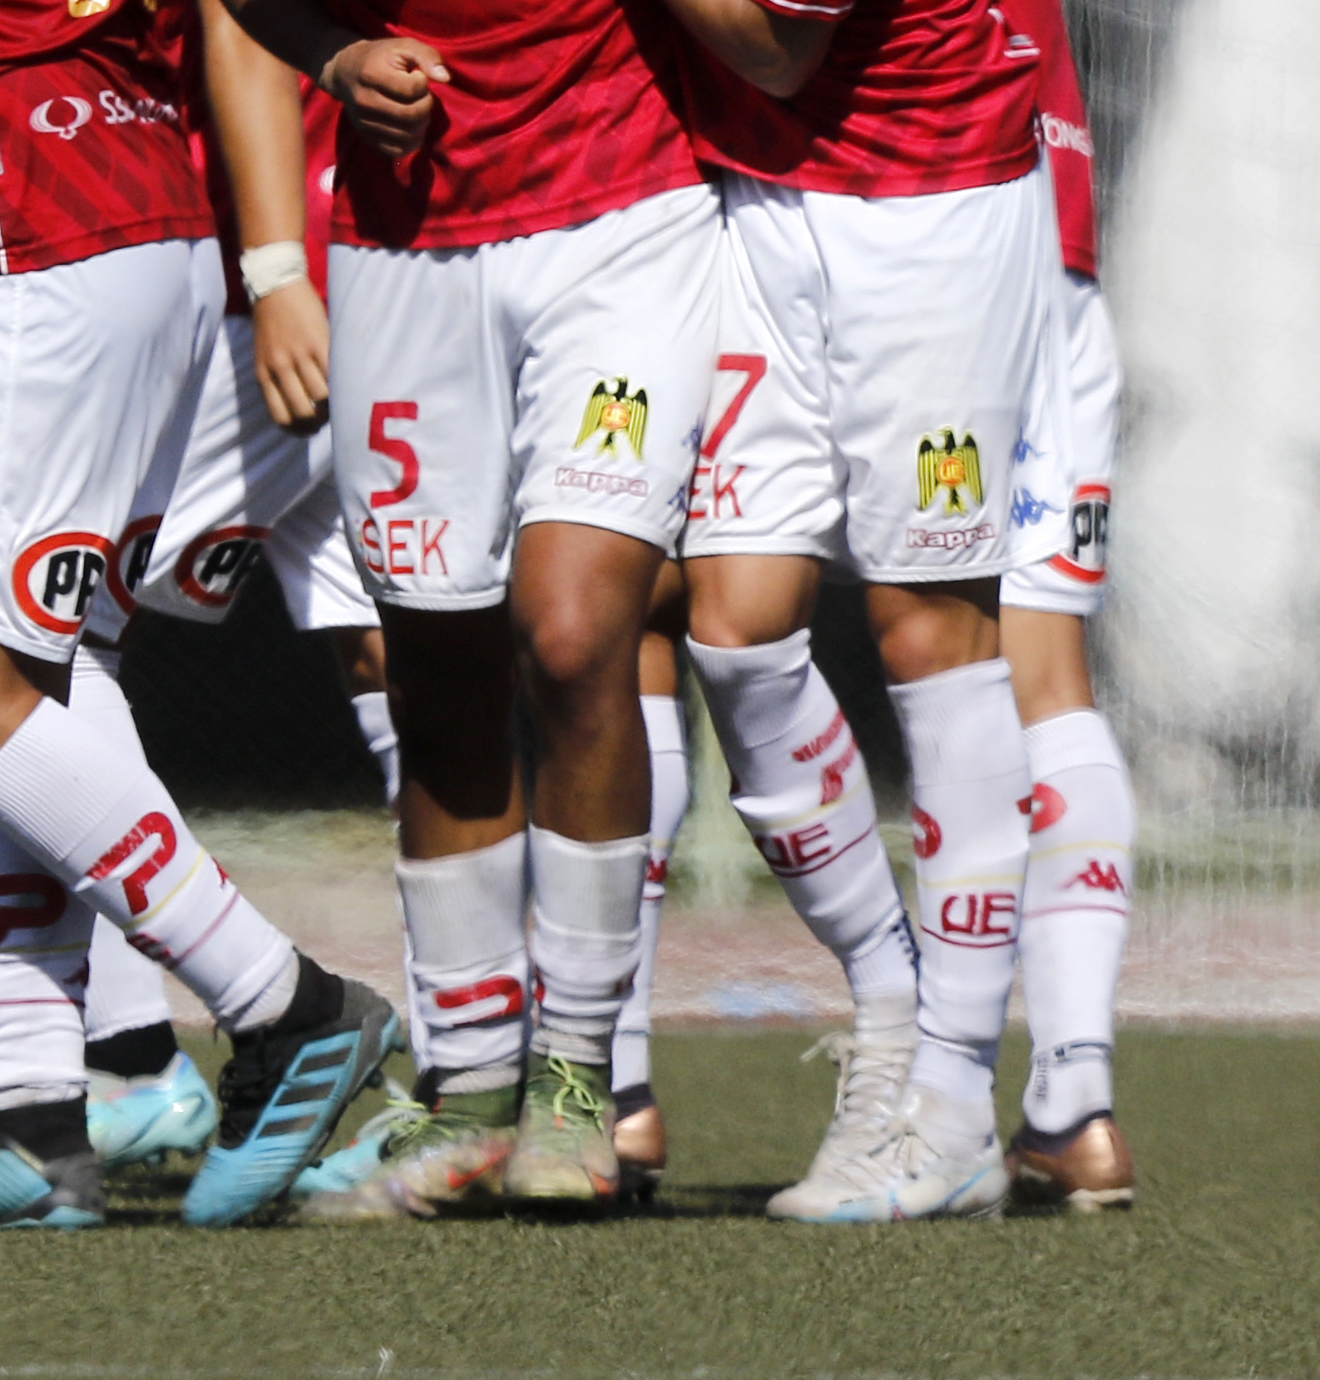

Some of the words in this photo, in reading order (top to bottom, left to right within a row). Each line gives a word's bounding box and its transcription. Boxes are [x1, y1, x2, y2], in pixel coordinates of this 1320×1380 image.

[700, 353, 768, 459] 7
[368, 400, 420, 508] 5
[554, 467, 648, 497] Kappa
[361, 517, 450, 576] SEK
[906, 523, 996, 550] Kappa
[941, 893, 1016, 936] UE
